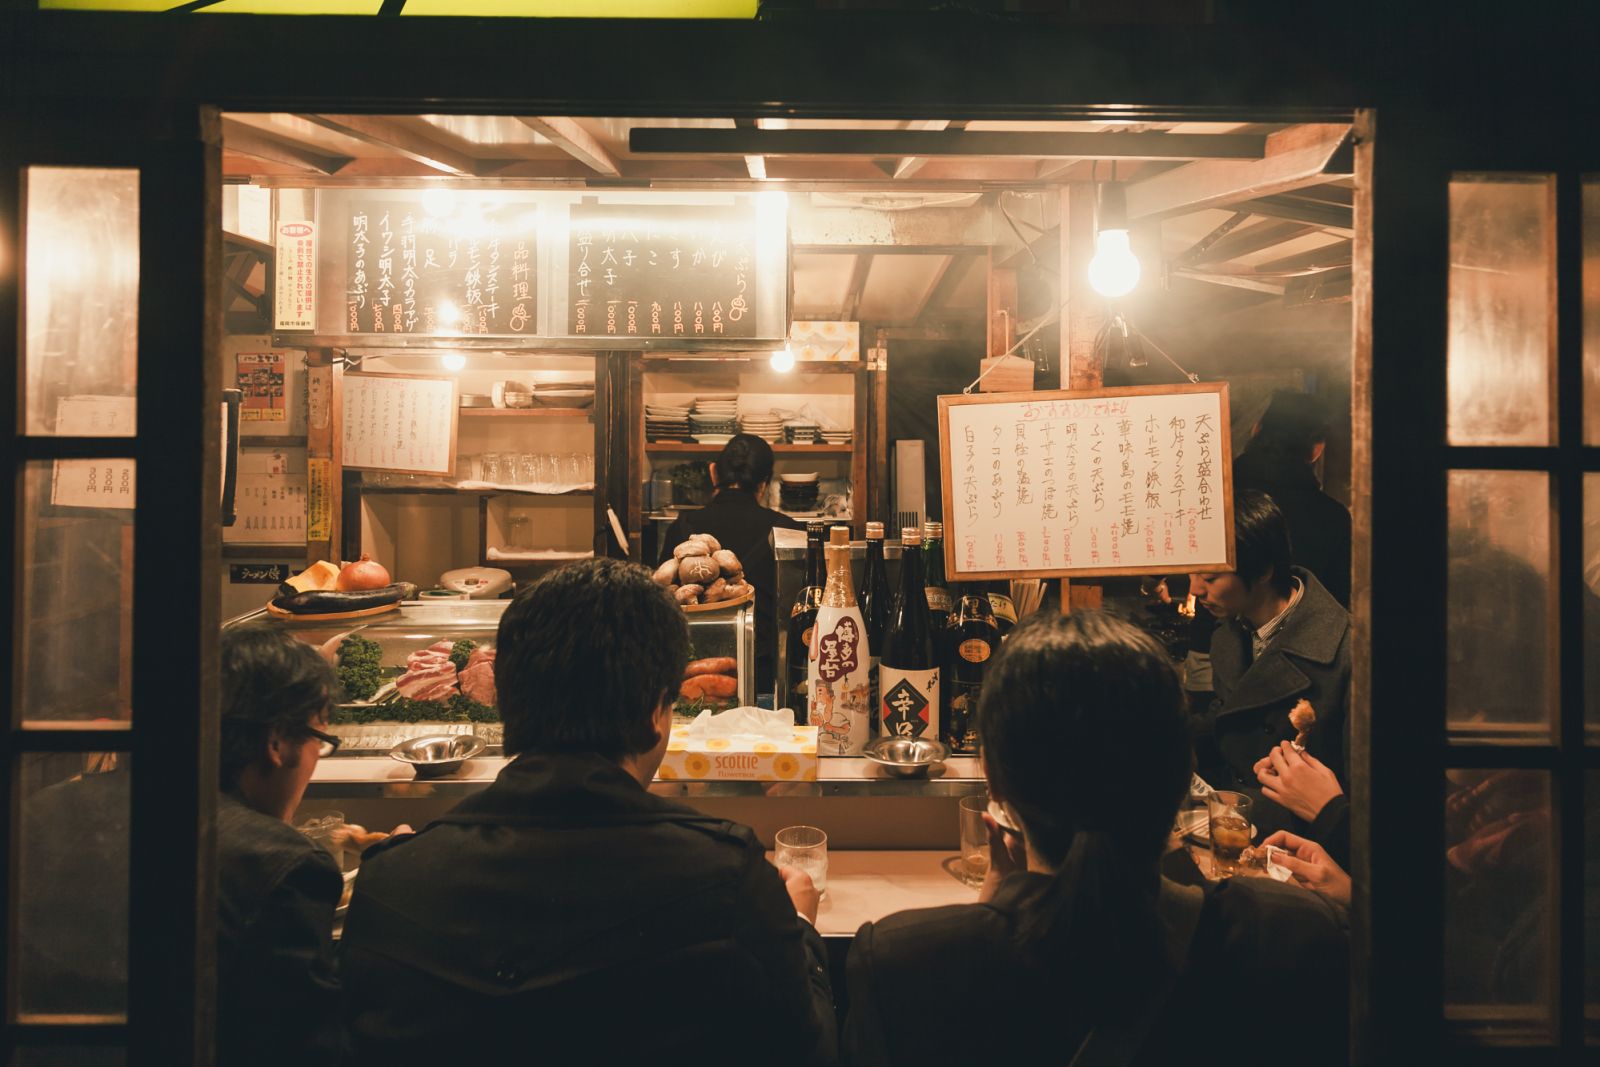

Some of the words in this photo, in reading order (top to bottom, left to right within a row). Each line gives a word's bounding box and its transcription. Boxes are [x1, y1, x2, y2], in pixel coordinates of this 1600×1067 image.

[353, 212, 369, 309] 明太子のあぶり
[377, 212, 395, 307] イワシ明太子
[1090, 422, 1105, 512] ふぐの天ぷら
[820, 639, 841, 678] 屋台
[835, 620, 855, 668] 博多の
[891, 688, 915, 736] 辛口
[715, 755, 759, 770] scottie
